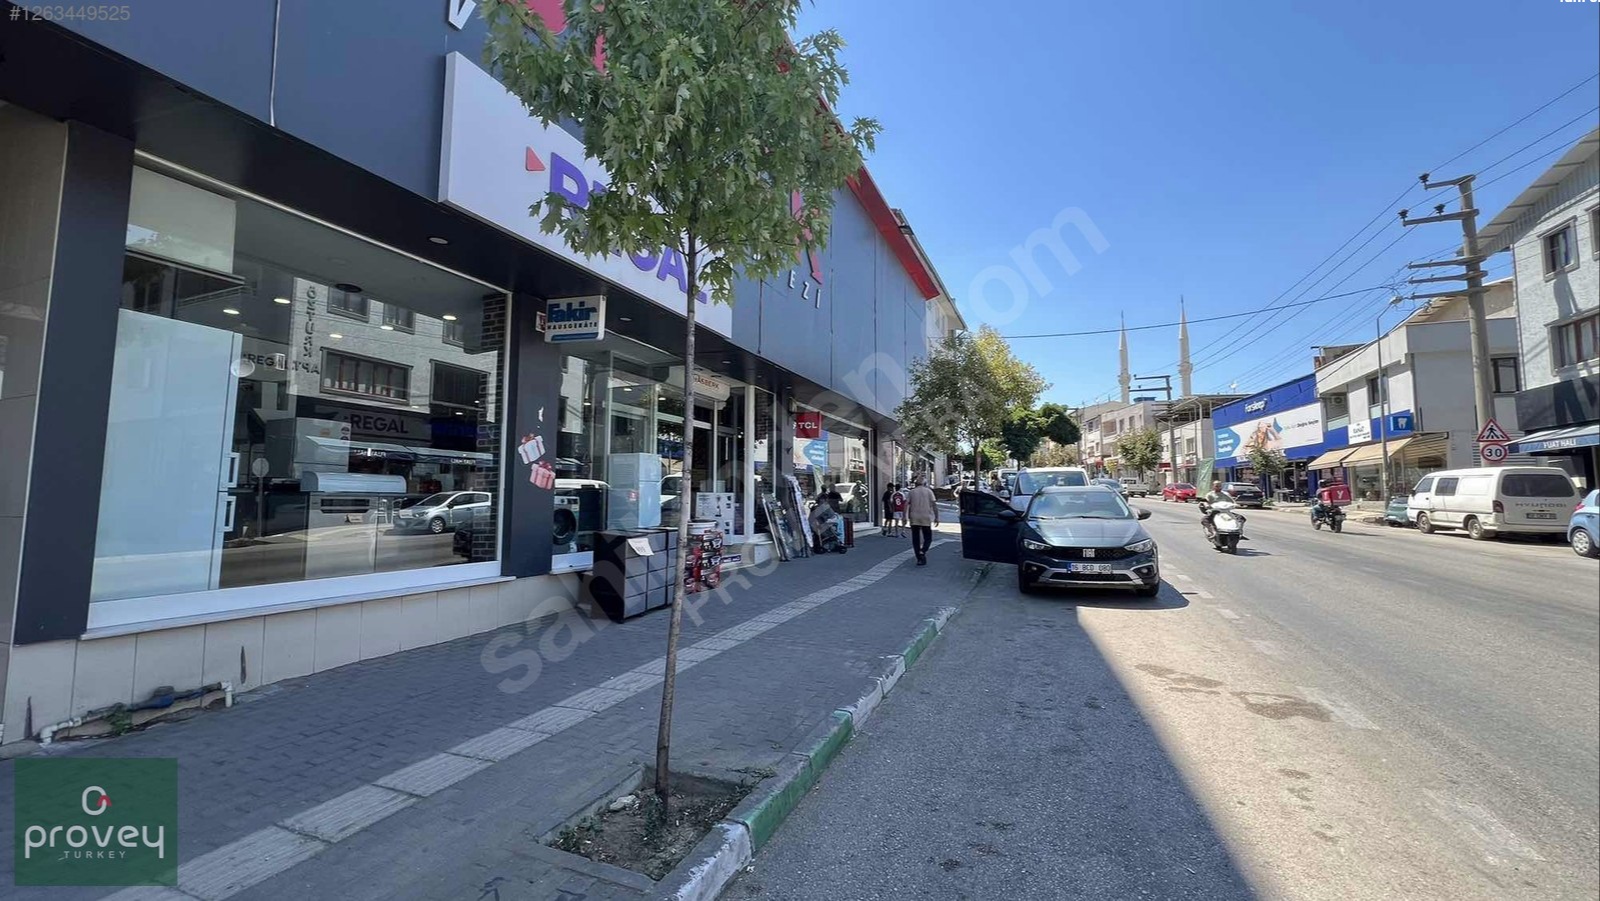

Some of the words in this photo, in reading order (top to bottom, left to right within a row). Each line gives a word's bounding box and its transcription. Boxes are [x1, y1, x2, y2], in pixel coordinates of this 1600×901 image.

[547, 301, 598, 323] Fakir
[247, 353, 289, 370] REGL
[350, 413, 409, 434] REGAL
[798, 421, 818, 429] TCL
[1485, 448, 1502, 458] 30
